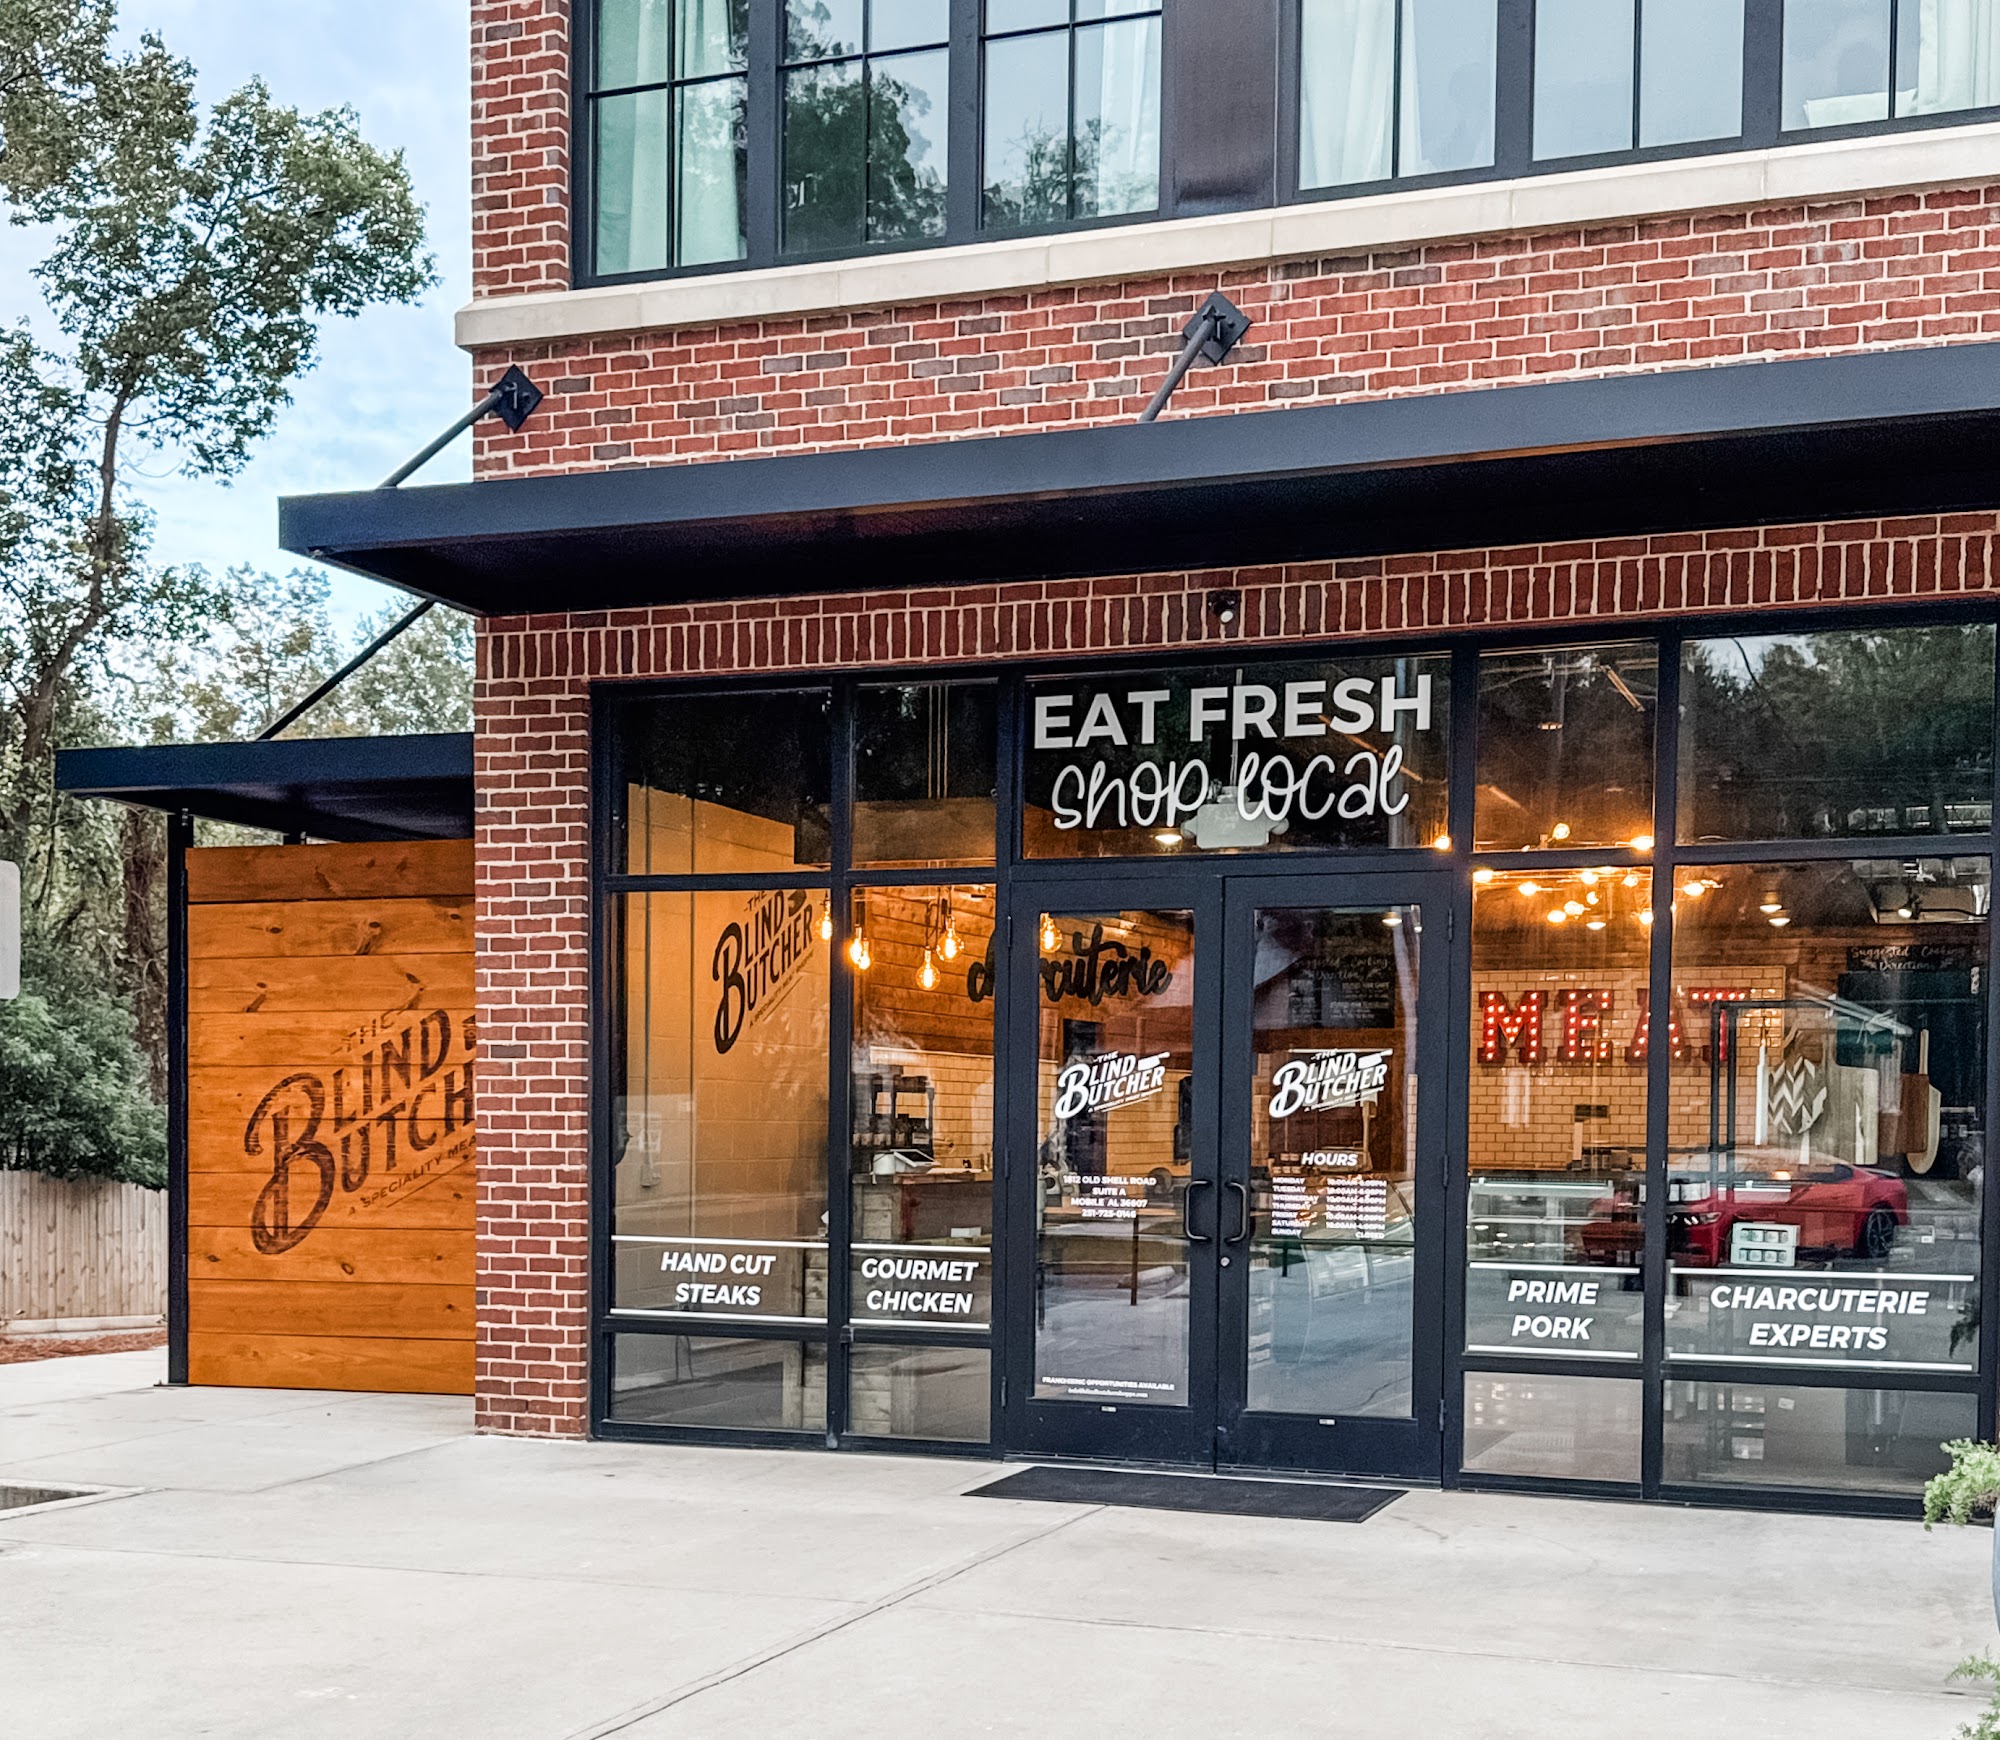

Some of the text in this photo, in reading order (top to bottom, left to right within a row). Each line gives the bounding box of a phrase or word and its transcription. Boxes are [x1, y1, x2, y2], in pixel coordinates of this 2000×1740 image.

[1034, 674, 1432, 750] EAT FRESH
[1476, 986, 1751, 1064] MEAT
[1096, 1051, 1118, 1063] THE
[1301, 1152, 1359, 1167] HOURS
[348, 1136, 476, 1217] A SPECIALITY MEA
[1082, 1175, 1101, 1185] OLD
[1101, 1176, 1129, 1185] SHELL
[1129, 1177, 1157, 1186] ROAD
[1071, 1197, 1105, 1207] MOBILE
[1107, 1198, 1119, 1207] AL
[1092, 1187, 1127, 1196] SUITE A
[660, 1251, 776, 1275] HAND CUT
[860, 1258, 980, 1282] GOURMET
[675, 1282, 762, 1306] STEAKS
[866, 1289, 973, 1314] CHICKEN
[1507, 1279, 1600, 1305] PRIME
[1709, 1285, 1930, 1315] CHARCUTERIE
[1511, 1315, 1594, 1340] PORK
[1748, 1323, 1889, 1351] EXPERTS
[1138, 1382, 1175, 1391] AVAILABLE
